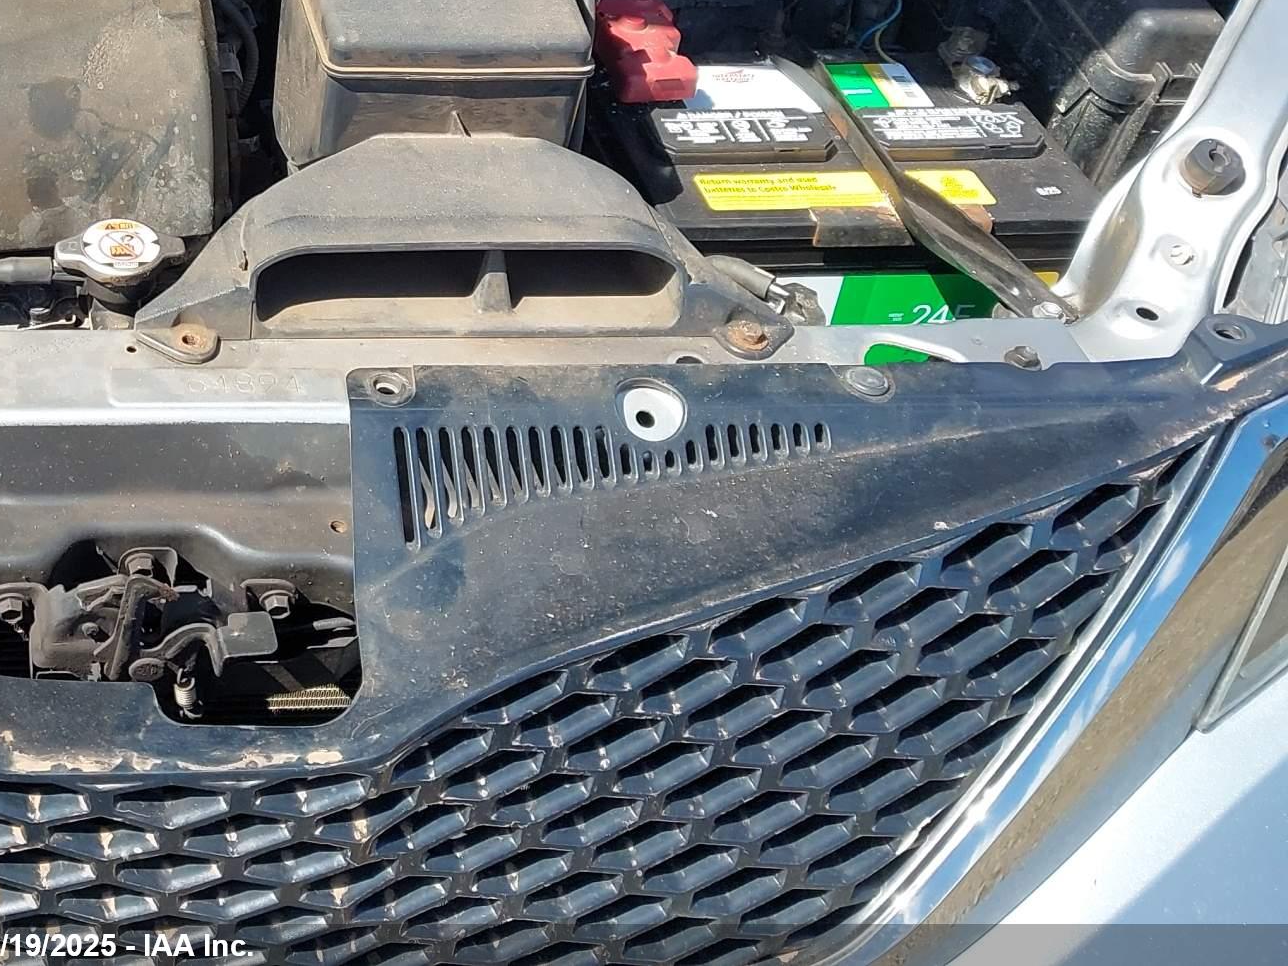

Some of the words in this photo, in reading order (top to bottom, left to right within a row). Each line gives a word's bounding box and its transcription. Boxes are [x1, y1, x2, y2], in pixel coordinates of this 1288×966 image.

[699, 177, 731, 185] Return
[734, 177, 775, 186] warranty
[704, 185, 745, 194] batteries
[747, 185, 757, 193] to
[760, 185, 789, 193] Costco
[791, 184, 837, 192] Wholesale
